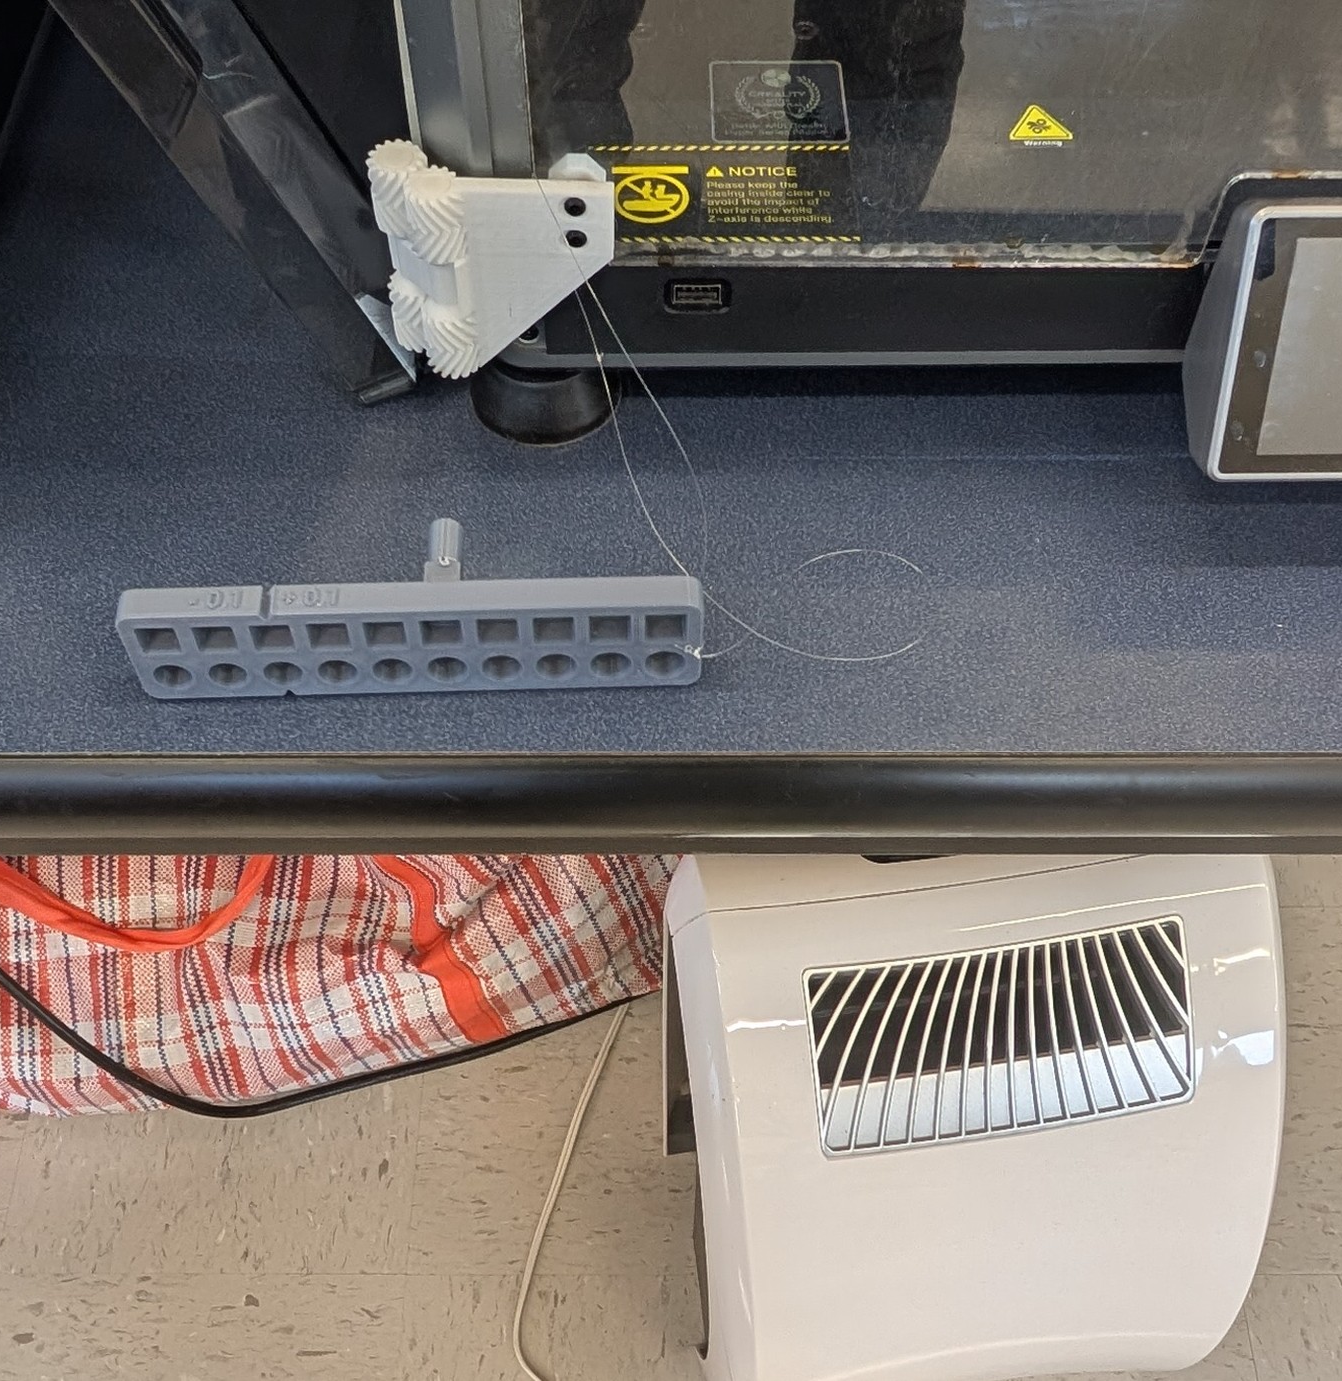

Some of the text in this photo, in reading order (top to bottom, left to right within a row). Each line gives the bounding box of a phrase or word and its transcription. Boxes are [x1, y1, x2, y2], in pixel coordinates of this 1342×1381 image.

[728, 166, 798, 177] NOTICE
[706, 181, 798, 190] Please keep the
[748, 189, 784, 197] inside
[786, 189, 814, 197] clear
[707, 198, 820, 207] avoid the impact of
[708, 215, 747, 223] Z-axis
